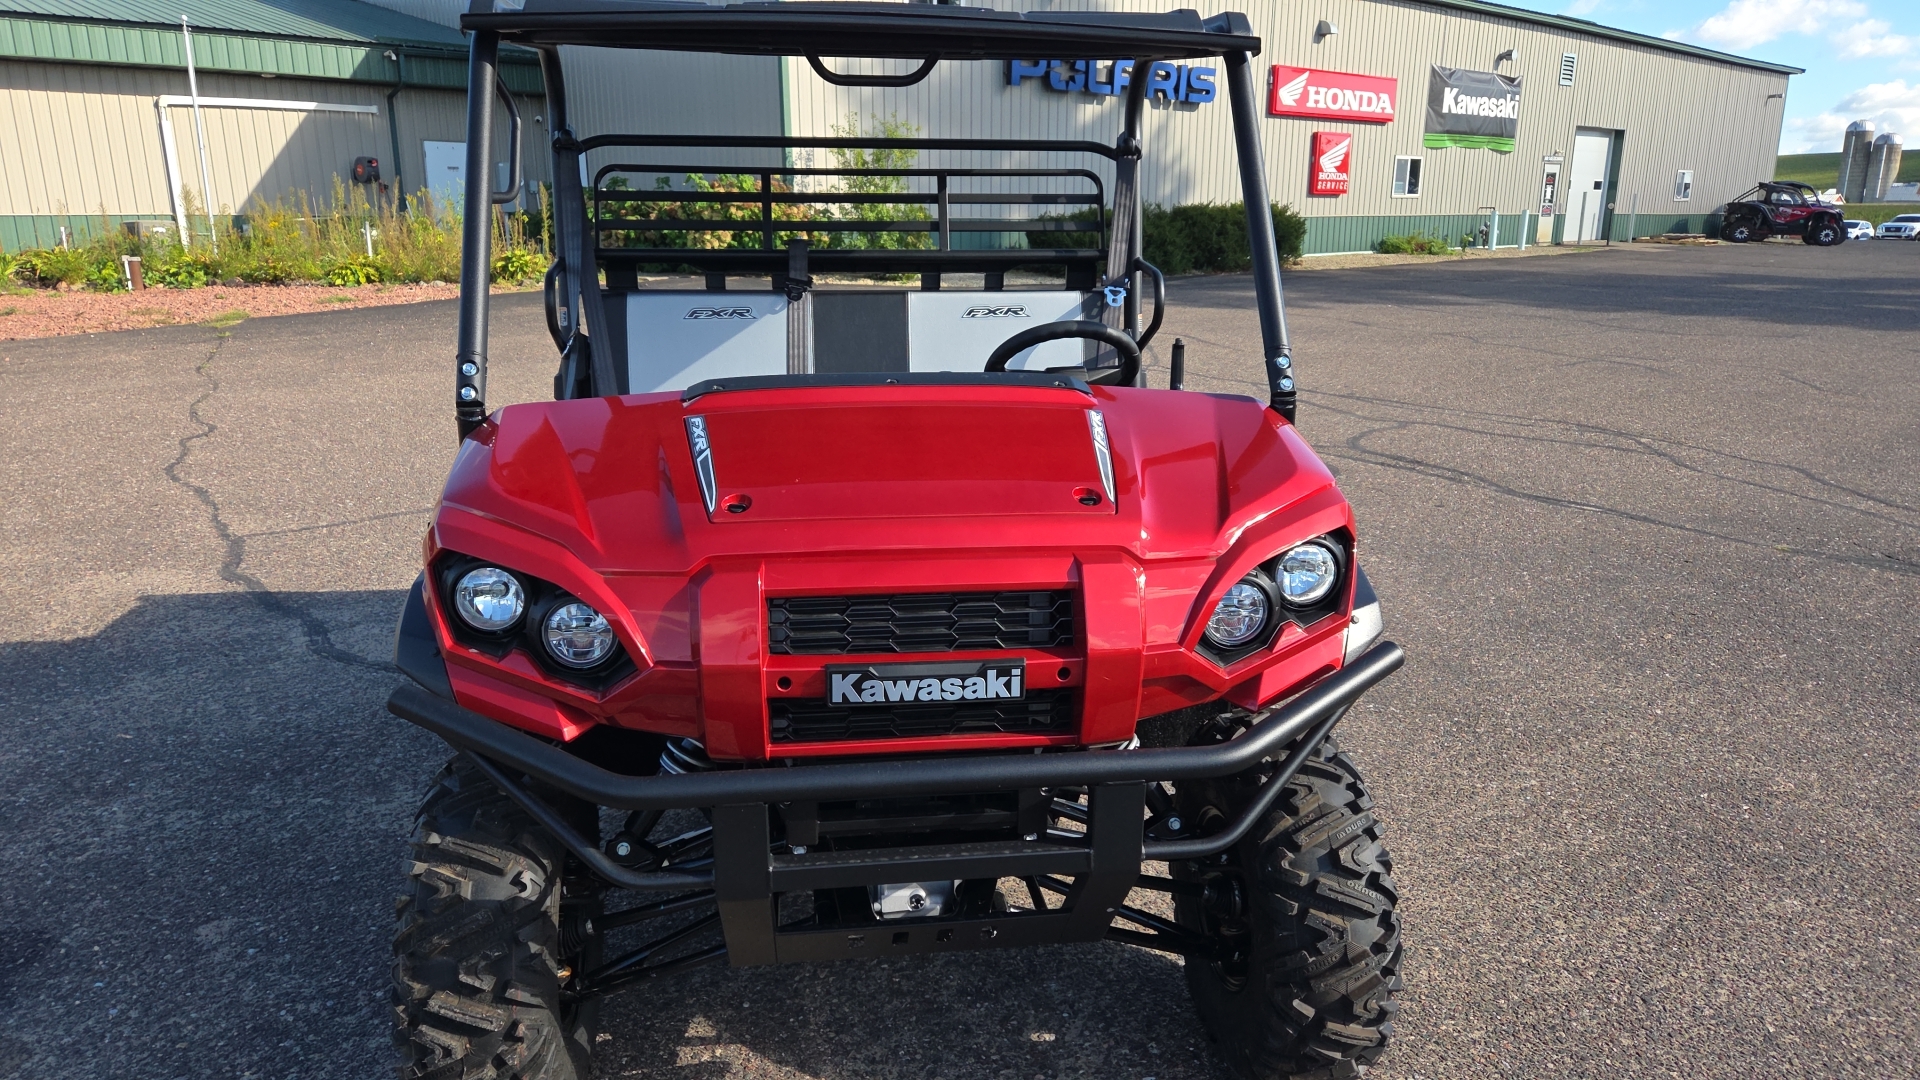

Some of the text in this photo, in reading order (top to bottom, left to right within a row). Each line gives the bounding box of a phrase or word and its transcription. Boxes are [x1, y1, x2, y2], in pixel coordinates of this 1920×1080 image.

[1008, 60, 1216, 103] POLARIS
[1306, 86, 1394, 114] HONDA
[1442, 87, 1520, 119] Kawasaki
[1317, 181, 1349, 190] SERVICE
[1318, 172, 1348, 180] HONDA
[684, 307, 757, 319] FXR
[961, 305, 1030, 318] FXR
[690, 417, 709, 453] FXR
[831, 668, 1022, 703] Kawasaki
